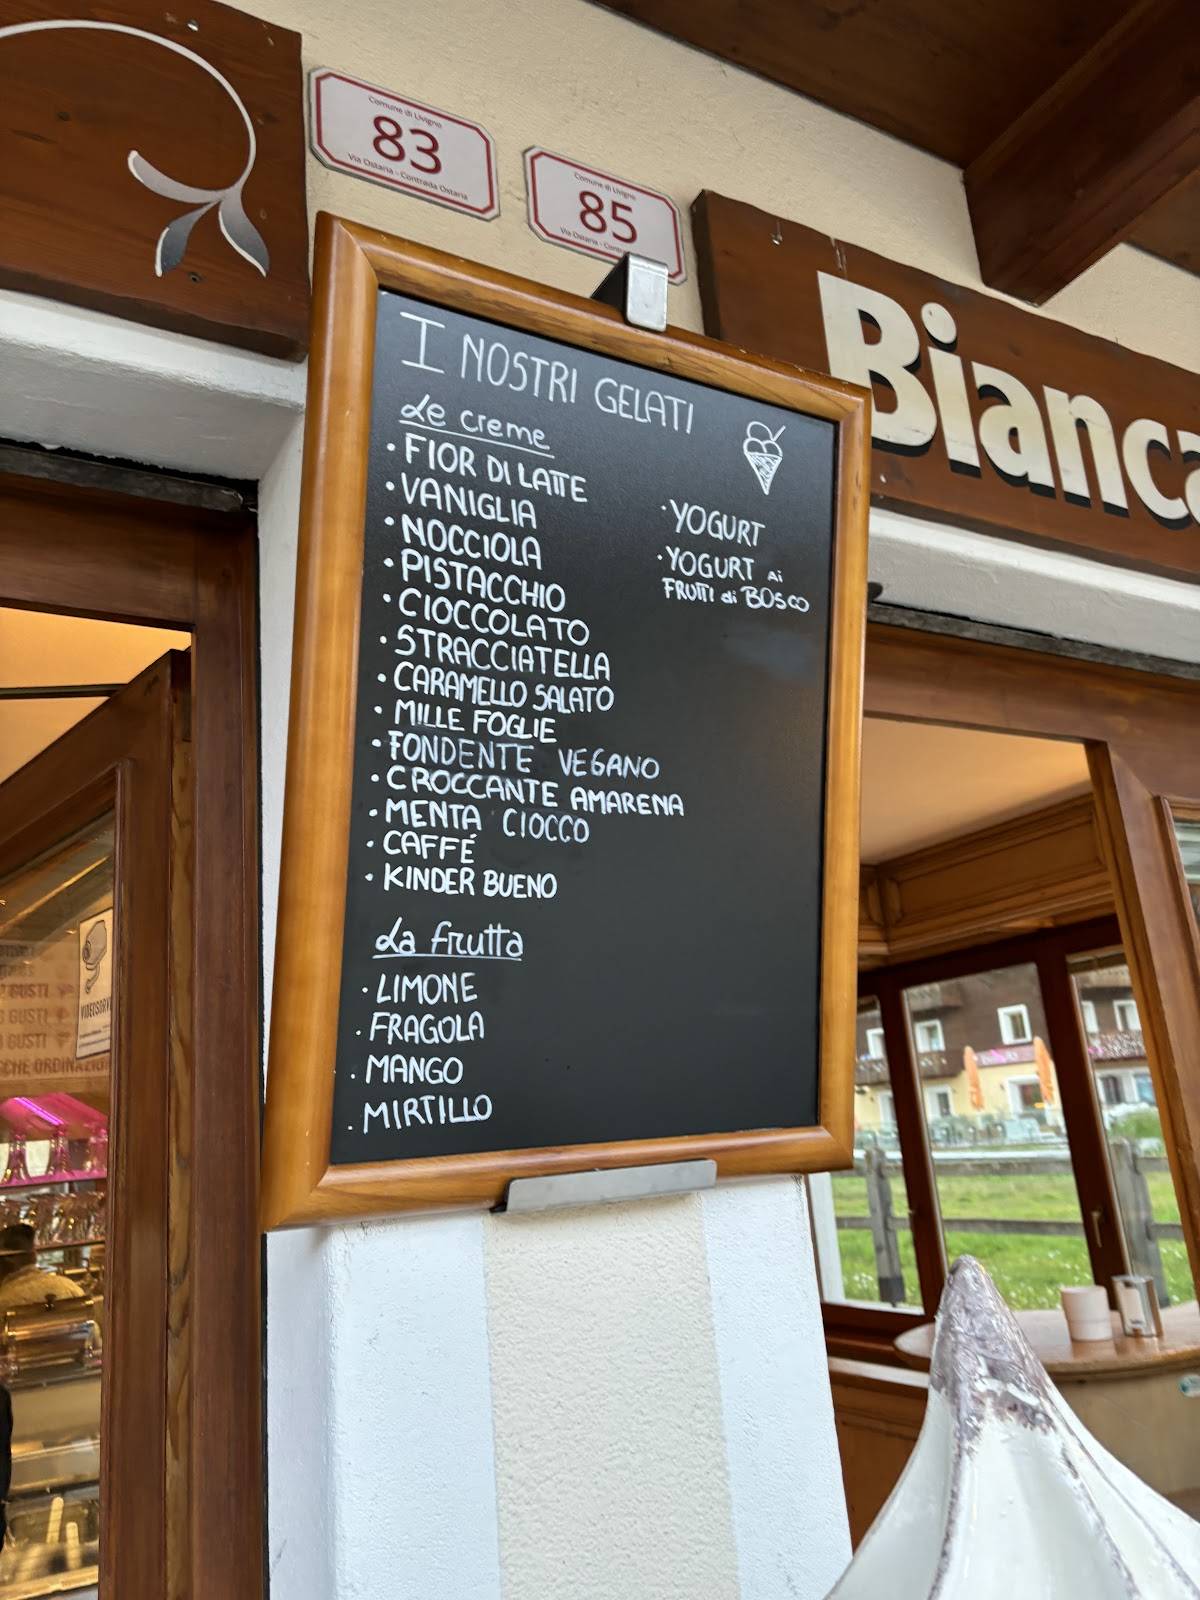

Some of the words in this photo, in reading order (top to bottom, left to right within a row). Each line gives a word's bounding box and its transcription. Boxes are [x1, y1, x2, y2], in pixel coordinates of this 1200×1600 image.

[368, 95, 403, 114] Comune
[405, 109, 413, 118] di
[414, 112, 442, 128] Livigno
[373, 115, 442, 175] 83
[348, 152, 361, 165] Via
[363, 158, 394, 175] Ostaria
[400, 171, 438, 190] Contrada
[439, 185, 469, 201] Ostaria
[574, 172, 603, 188] Comune
[560, 226, 572, 237] Via
[579, 190, 638, 244] 85
[400, 312, 445, 373] I
[461, 334, 577, 403] NOSTRI
[595, 378, 693, 434] GELATI
[460, 410, 550, 450] creme
[406, 433, 476, 477] FIOR
[487, 455, 511, 485] DI
[518, 463, 587, 502] LATTE
[401, 472, 536, 529] VANIGLIA
[670, 499, 765, 547] YOGURT
[402, 514, 542, 570] NOCCIOLA
[666, 546, 754, 581] YOGURT
[401, 548, 565, 612] PISTACCHIO
[721, 591, 737, 604] di
[740, 586, 809, 612] BOSCO
[399, 588, 589, 646] CIOCCOLATO
[395, 624, 610, 681] STRACCIATELLA
[394, 661, 527, 708] CARAMELLO
[533, 684, 614, 714] SALATO
[395, 699, 465, 731] MILLE
[473, 710, 557, 743] FOGLIE
[388, 730, 534, 773] FONDENTE
[558, 748, 659, 779] VEGANO
[387, 765, 558, 807] CROCCANTE
[570, 787, 684, 816] AMARENA
[386, 798, 482, 830] MENTA
[503, 808, 589, 843] CIOCCO
[384, 863, 475, 896] KINDER
[483, 870, 557, 898] BUENO
[430, 920, 524, 957] frutta
[377, 972, 477, 1005] LIMONE
[369, 1011, 484, 1045] FRAGOLA
[366, 1054, 463, 1084] MANGO
[363, 1094, 492, 1134] MIRTILLO
